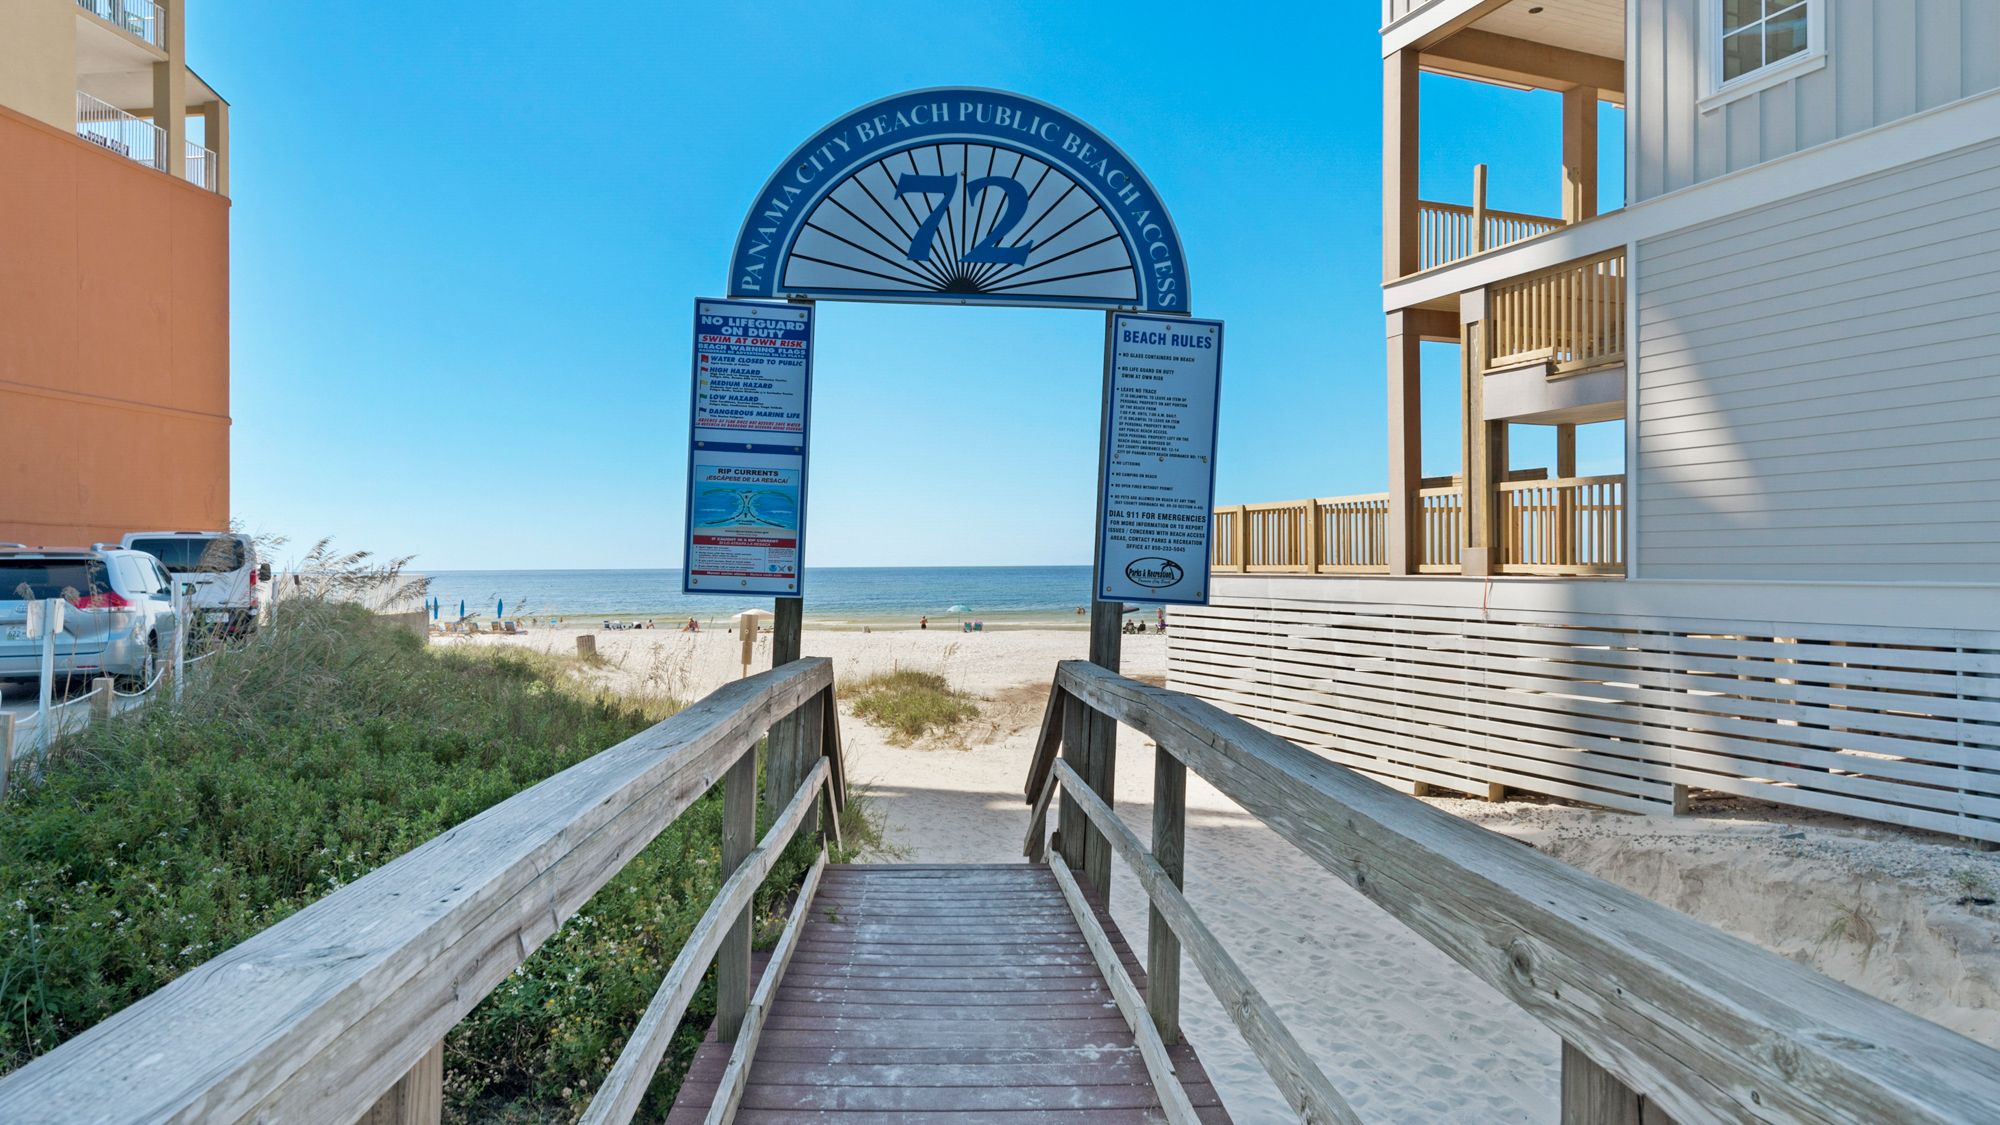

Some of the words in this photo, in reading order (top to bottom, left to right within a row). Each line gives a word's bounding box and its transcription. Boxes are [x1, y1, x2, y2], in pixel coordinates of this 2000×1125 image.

[741, 183, 801, 291] PANAMA
[796, 131, 850, 184] CITY
[856, 103, 949, 143] BEACH
[959, 102, 1060, 141] PUBLIC
[1062, 132, 1141, 206] BEACH
[1131, 210, 1176, 307] ACCESS
[894, 172, 1034, 266] 72
[702, 316, 723, 325] NO
[728, 318, 805, 331] LIFEGUARD
[721, 327, 743, 335] ON
[748, 328, 784, 338] DUTY
[702, 335, 731, 343] SWIM
[752, 338, 776, 346] OWN
[780, 339, 803, 347] RISK
[1123, 330, 1166, 345] BEACH
[1171, 334, 1212, 349] RULES
[730, 345, 775, 353] WARNING
[734, 469, 778, 477] CURRENTS
[1158, 513, 1206, 522] EMERGENCIES
[1147, 570, 1172, 579] Recreation
